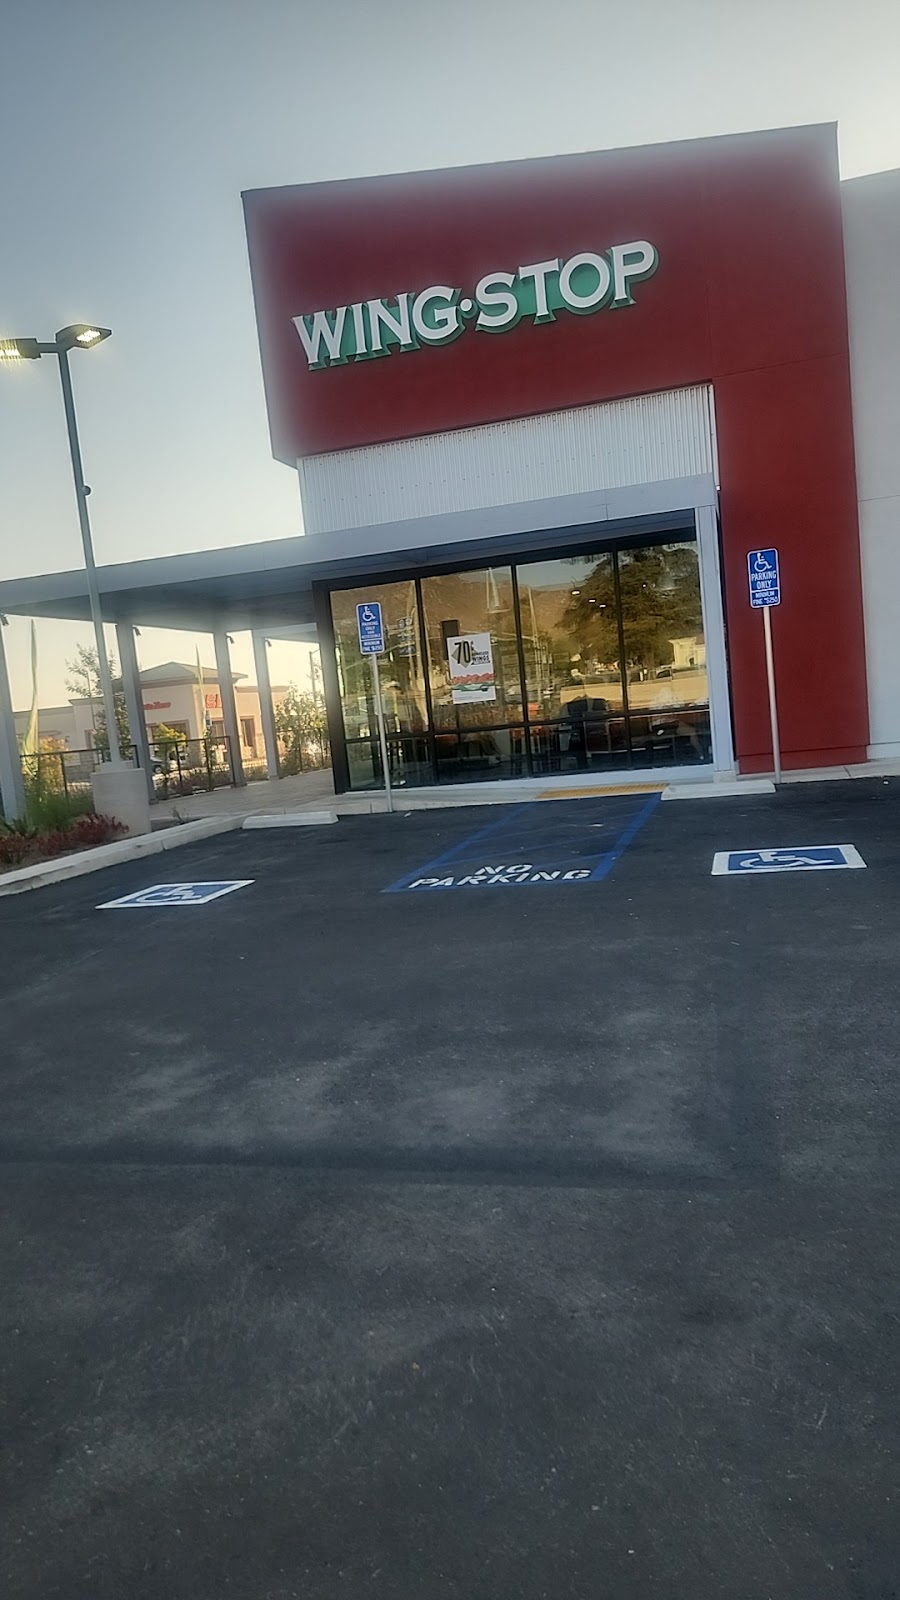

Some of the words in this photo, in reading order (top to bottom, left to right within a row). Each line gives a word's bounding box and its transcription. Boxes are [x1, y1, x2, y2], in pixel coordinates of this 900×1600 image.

[751, 570, 777, 582] PARKING
[756, 580, 772, 589] ONLY
[474, 864, 533, 876] NO
[408, 869, 592, 889] PARKING
